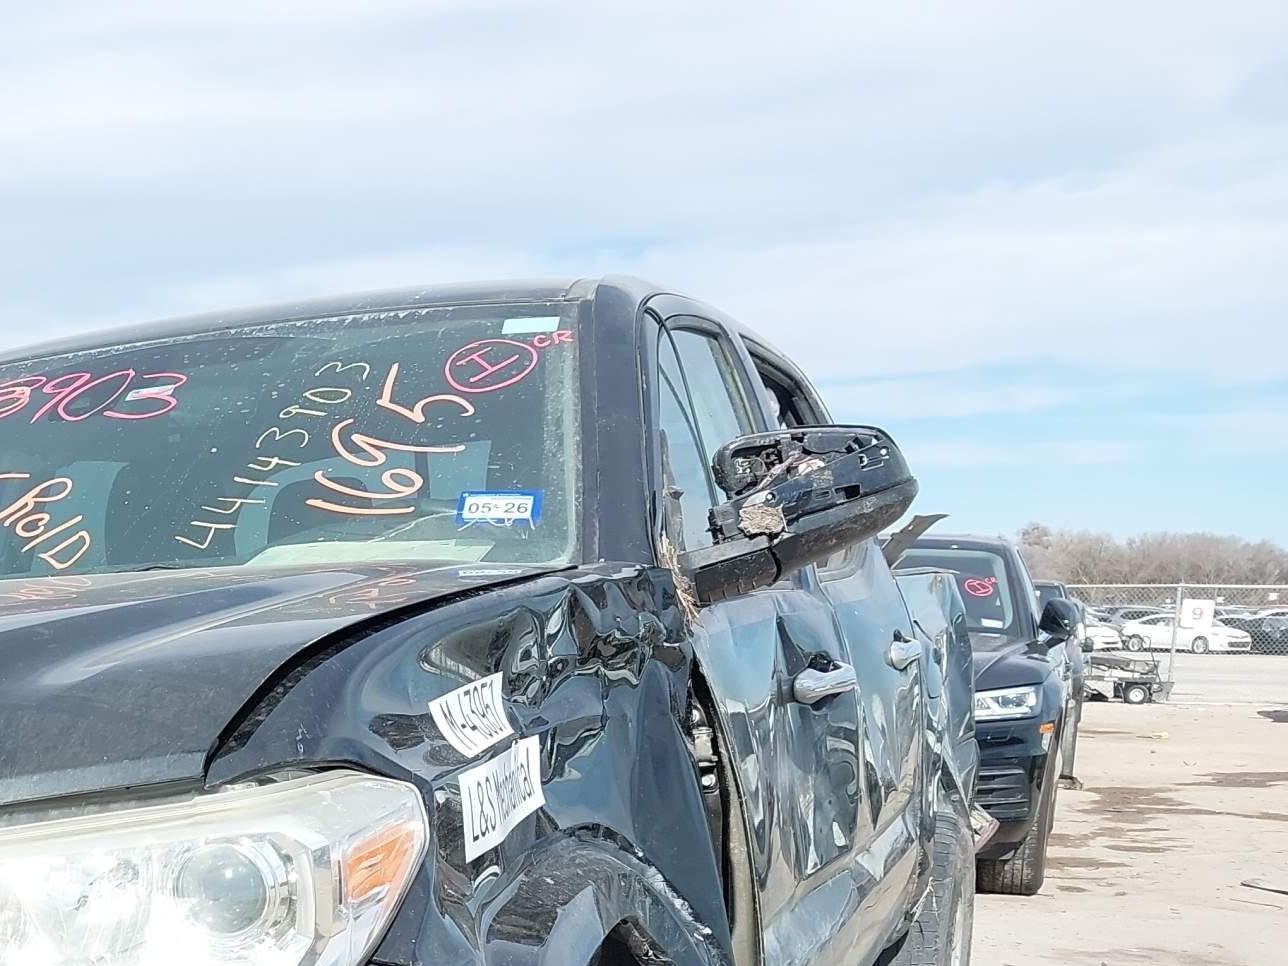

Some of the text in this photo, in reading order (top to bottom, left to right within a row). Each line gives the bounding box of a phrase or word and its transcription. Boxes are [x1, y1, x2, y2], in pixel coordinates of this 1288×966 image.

[174, 361, 370, 549] 44143903
[305, 362, 476, 516] 1695
[468, 776, 497, 843] L&S
